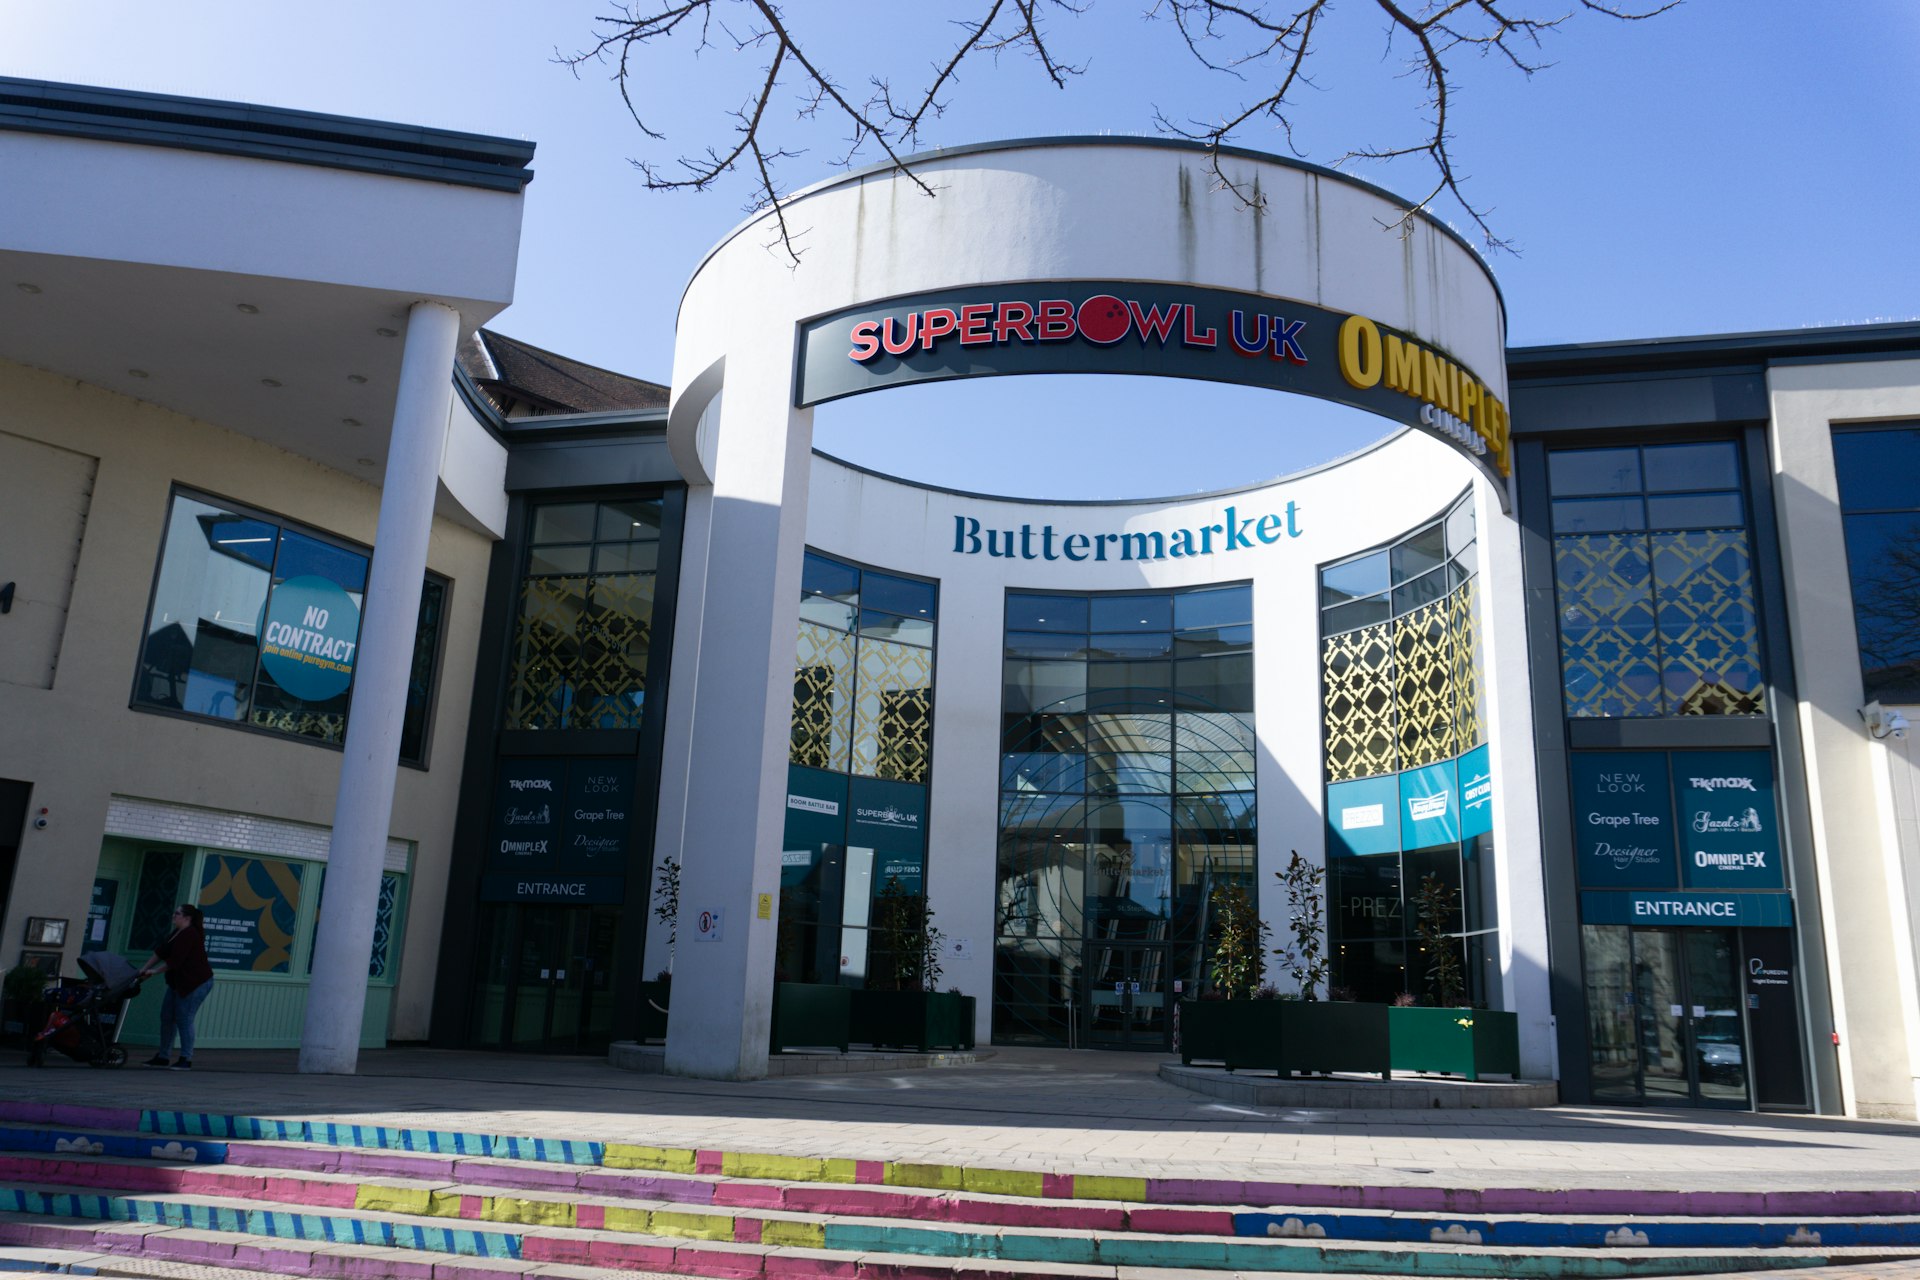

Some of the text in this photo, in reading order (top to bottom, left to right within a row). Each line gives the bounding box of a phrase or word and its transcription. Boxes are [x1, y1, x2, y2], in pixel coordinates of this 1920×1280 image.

[847, 293, 1309, 364] SUPERBOWL UK
[1339, 315, 1511, 477] OMNIPLEX
[1420, 404, 1486, 455] CINEMAS
[952, 500, 1304, 561] Buttermarket
[302, 605, 329, 630] NO
[266, 621, 355, 663] CONTRACT
[263, 642, 352, 673] join online puregym.com
[587, 776, 618, 785] NEW
[1600, 773, 1640, 783] NEW
[584, 784, 620, 793] LOOK
[1597, 783, 1646, 793] LOOK
[790, 798, 807, 806] BOOM
[808, 801, 825, 809] BATTLE
[574, 809, 625, 823] Grape Tree
[906, 813, 918, 823] UK
[1588, 812, 1659, 828] Grape Tree
[501, 839, 548, 854] OMNIPLEX
[574, 834, 619, 857] Deesigner
[1594, 842, 1657, 869] Deesigner
[1635, 856, 1660, 864] Studio
[1695, 850, 1766, 867] OMNIPLEX
[517, 882, 586, 896] ENTRANCE
[1635, 901, 1736, 917] ENTRANCE
